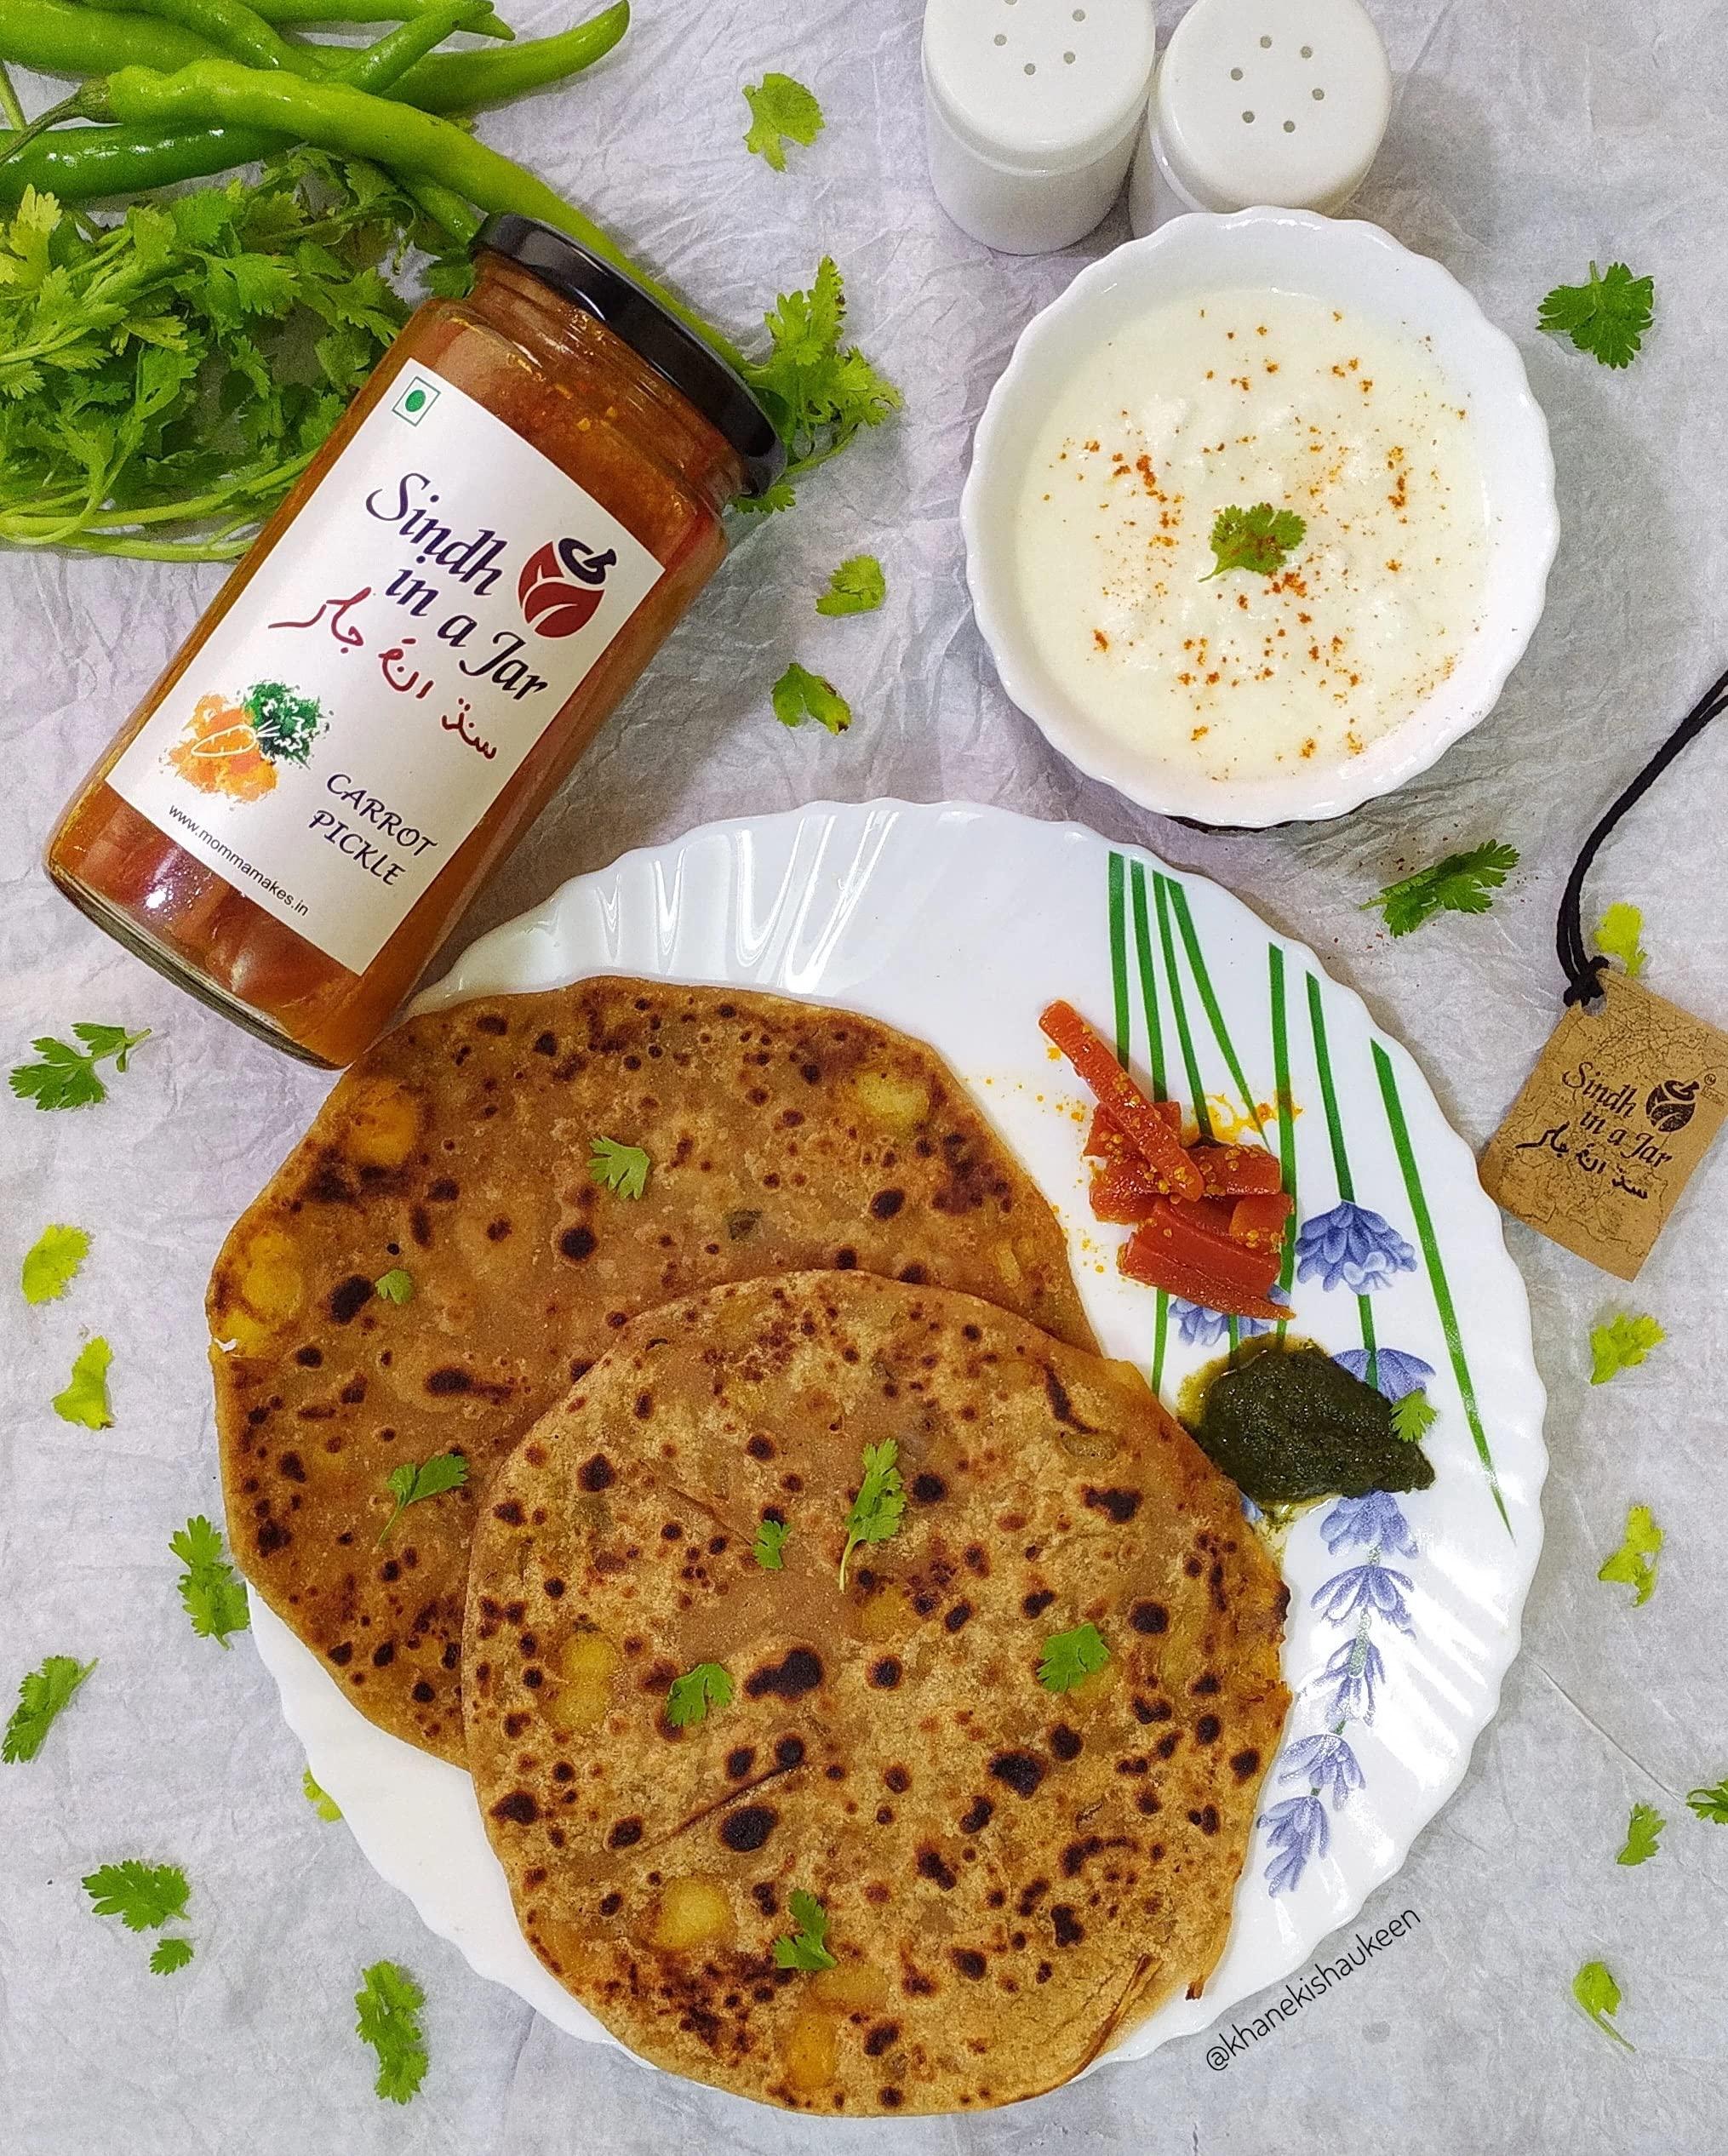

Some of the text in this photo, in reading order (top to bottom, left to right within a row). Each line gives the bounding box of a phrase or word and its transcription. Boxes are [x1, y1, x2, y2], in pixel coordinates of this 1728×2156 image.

[365, 472, 508, 597] Sindh
[385, 554, 549, 701] in a Jar
[308, 809, 407, 886] PICKLE
[327, 774, 438, 856] CARROT
[169, 805, 310, 917] www.mommamakes.in
[1562, 1061, 1637, 1118] Sindh
[1579, 1103, 1673, 1168] in a Jar
